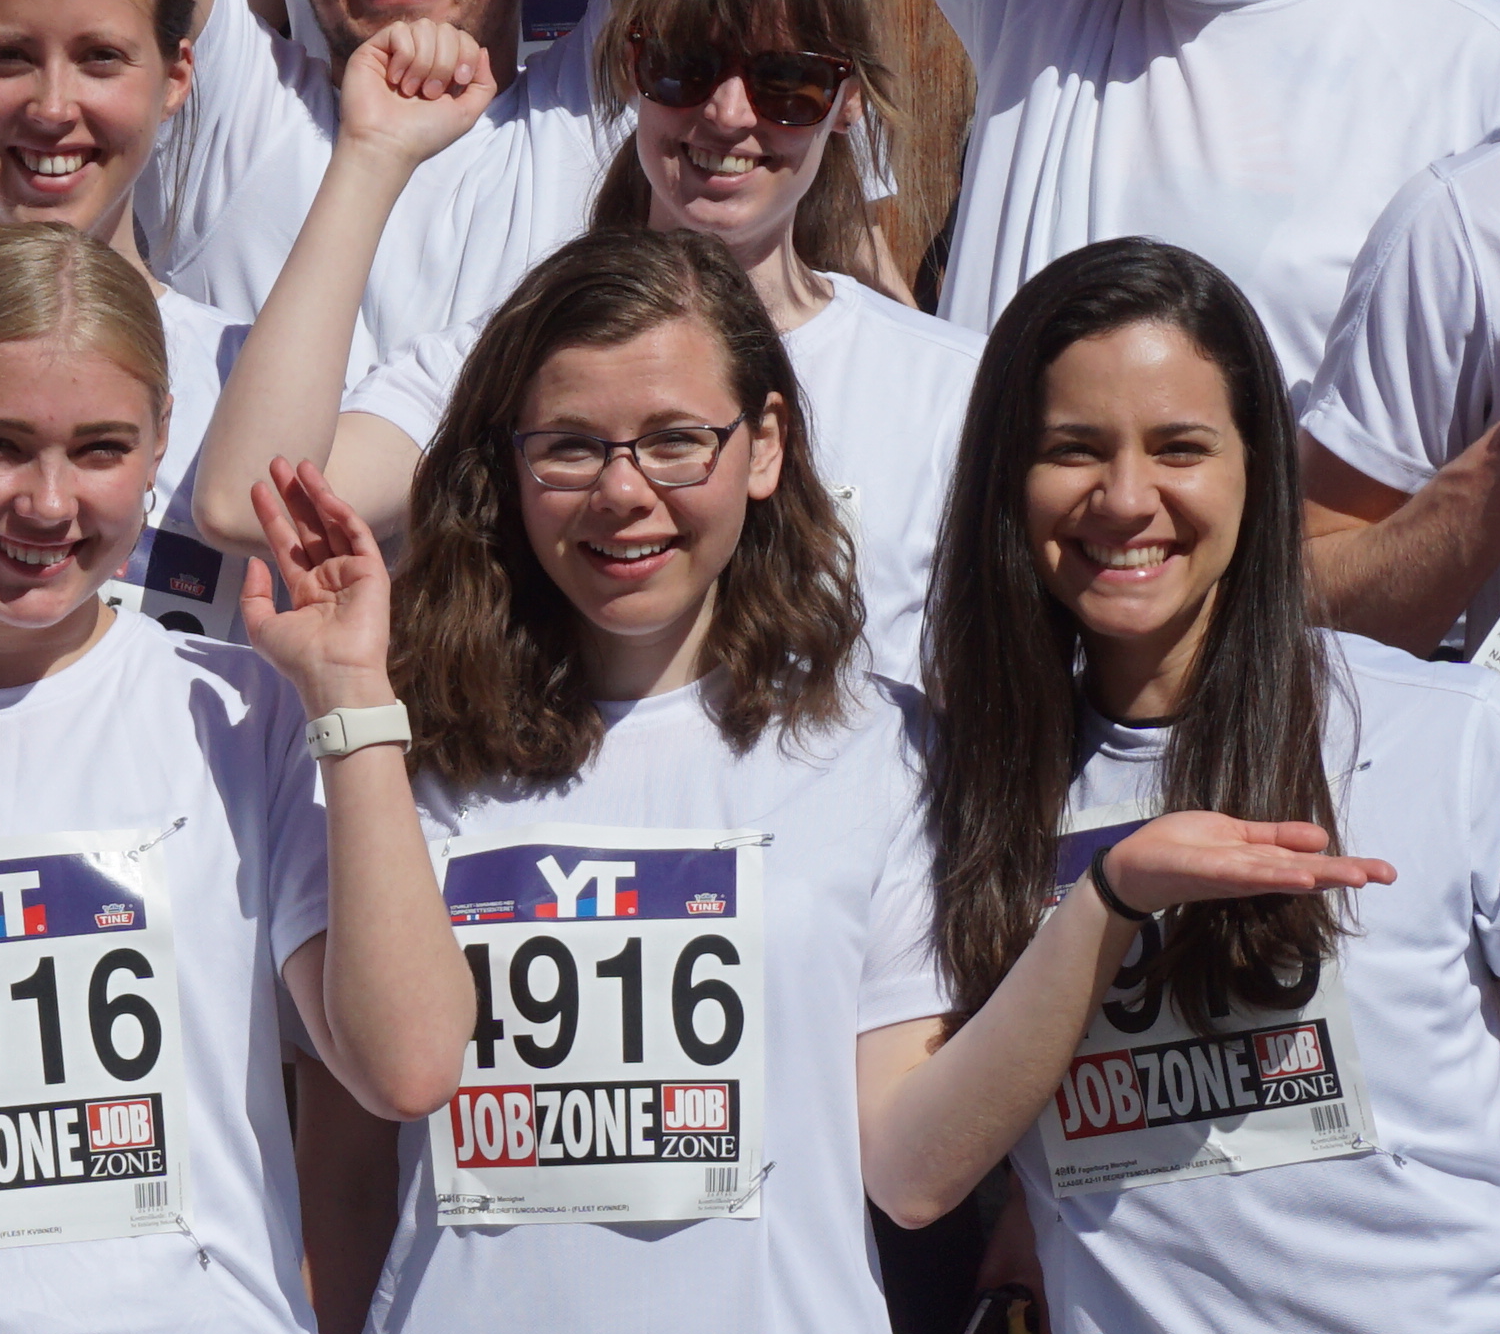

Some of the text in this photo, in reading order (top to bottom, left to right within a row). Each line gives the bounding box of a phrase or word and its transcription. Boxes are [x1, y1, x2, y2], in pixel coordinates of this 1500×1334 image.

[174, 581, 199, 594] TINE
[536, 854, 636, 918] YT
[99, 912, 130, 925] TINE
[690, 902, 721, 912] TINE
[1260, 1031, 1321, 1075] JOB
[1262, 1073, 1339, 1106] ZONE
[665, 1088, 725, 1129] JOB
[91, 1102, 151, 1148] JOB
[661, 1135, 736, 1158] ZONE
[90, 1150, 164, 1178] ZONE
